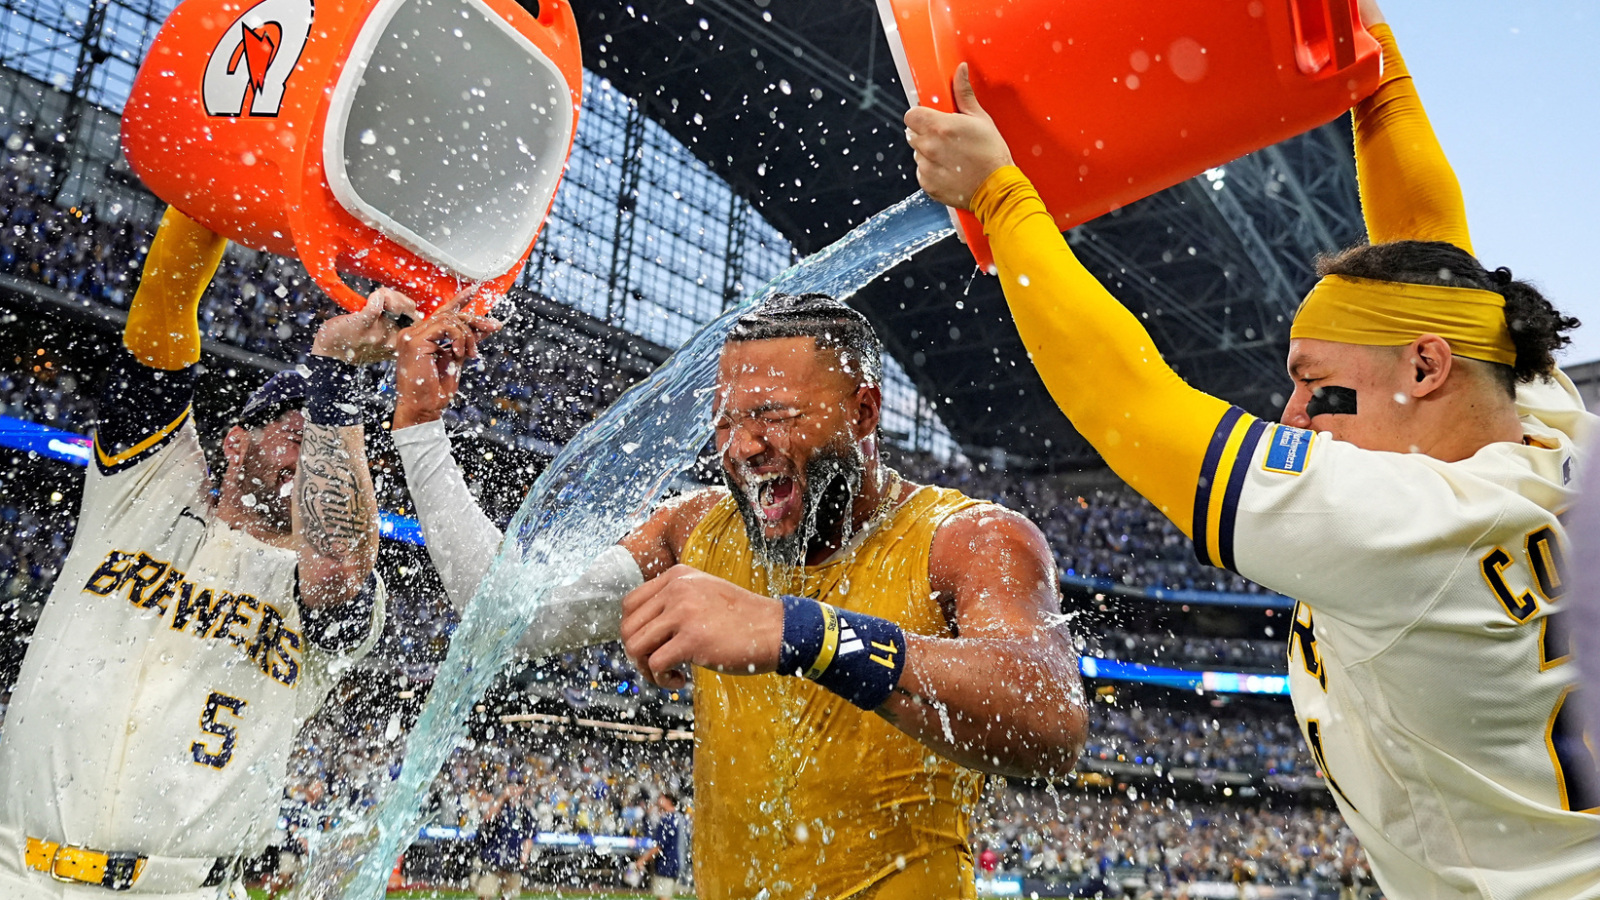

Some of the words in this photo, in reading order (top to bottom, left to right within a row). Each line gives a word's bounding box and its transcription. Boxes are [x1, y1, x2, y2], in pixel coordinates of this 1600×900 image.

[81, 549, 303, 689] BREWERS
[869, 639, 898, 670] 11
[188, 689, 249, 771] 5
